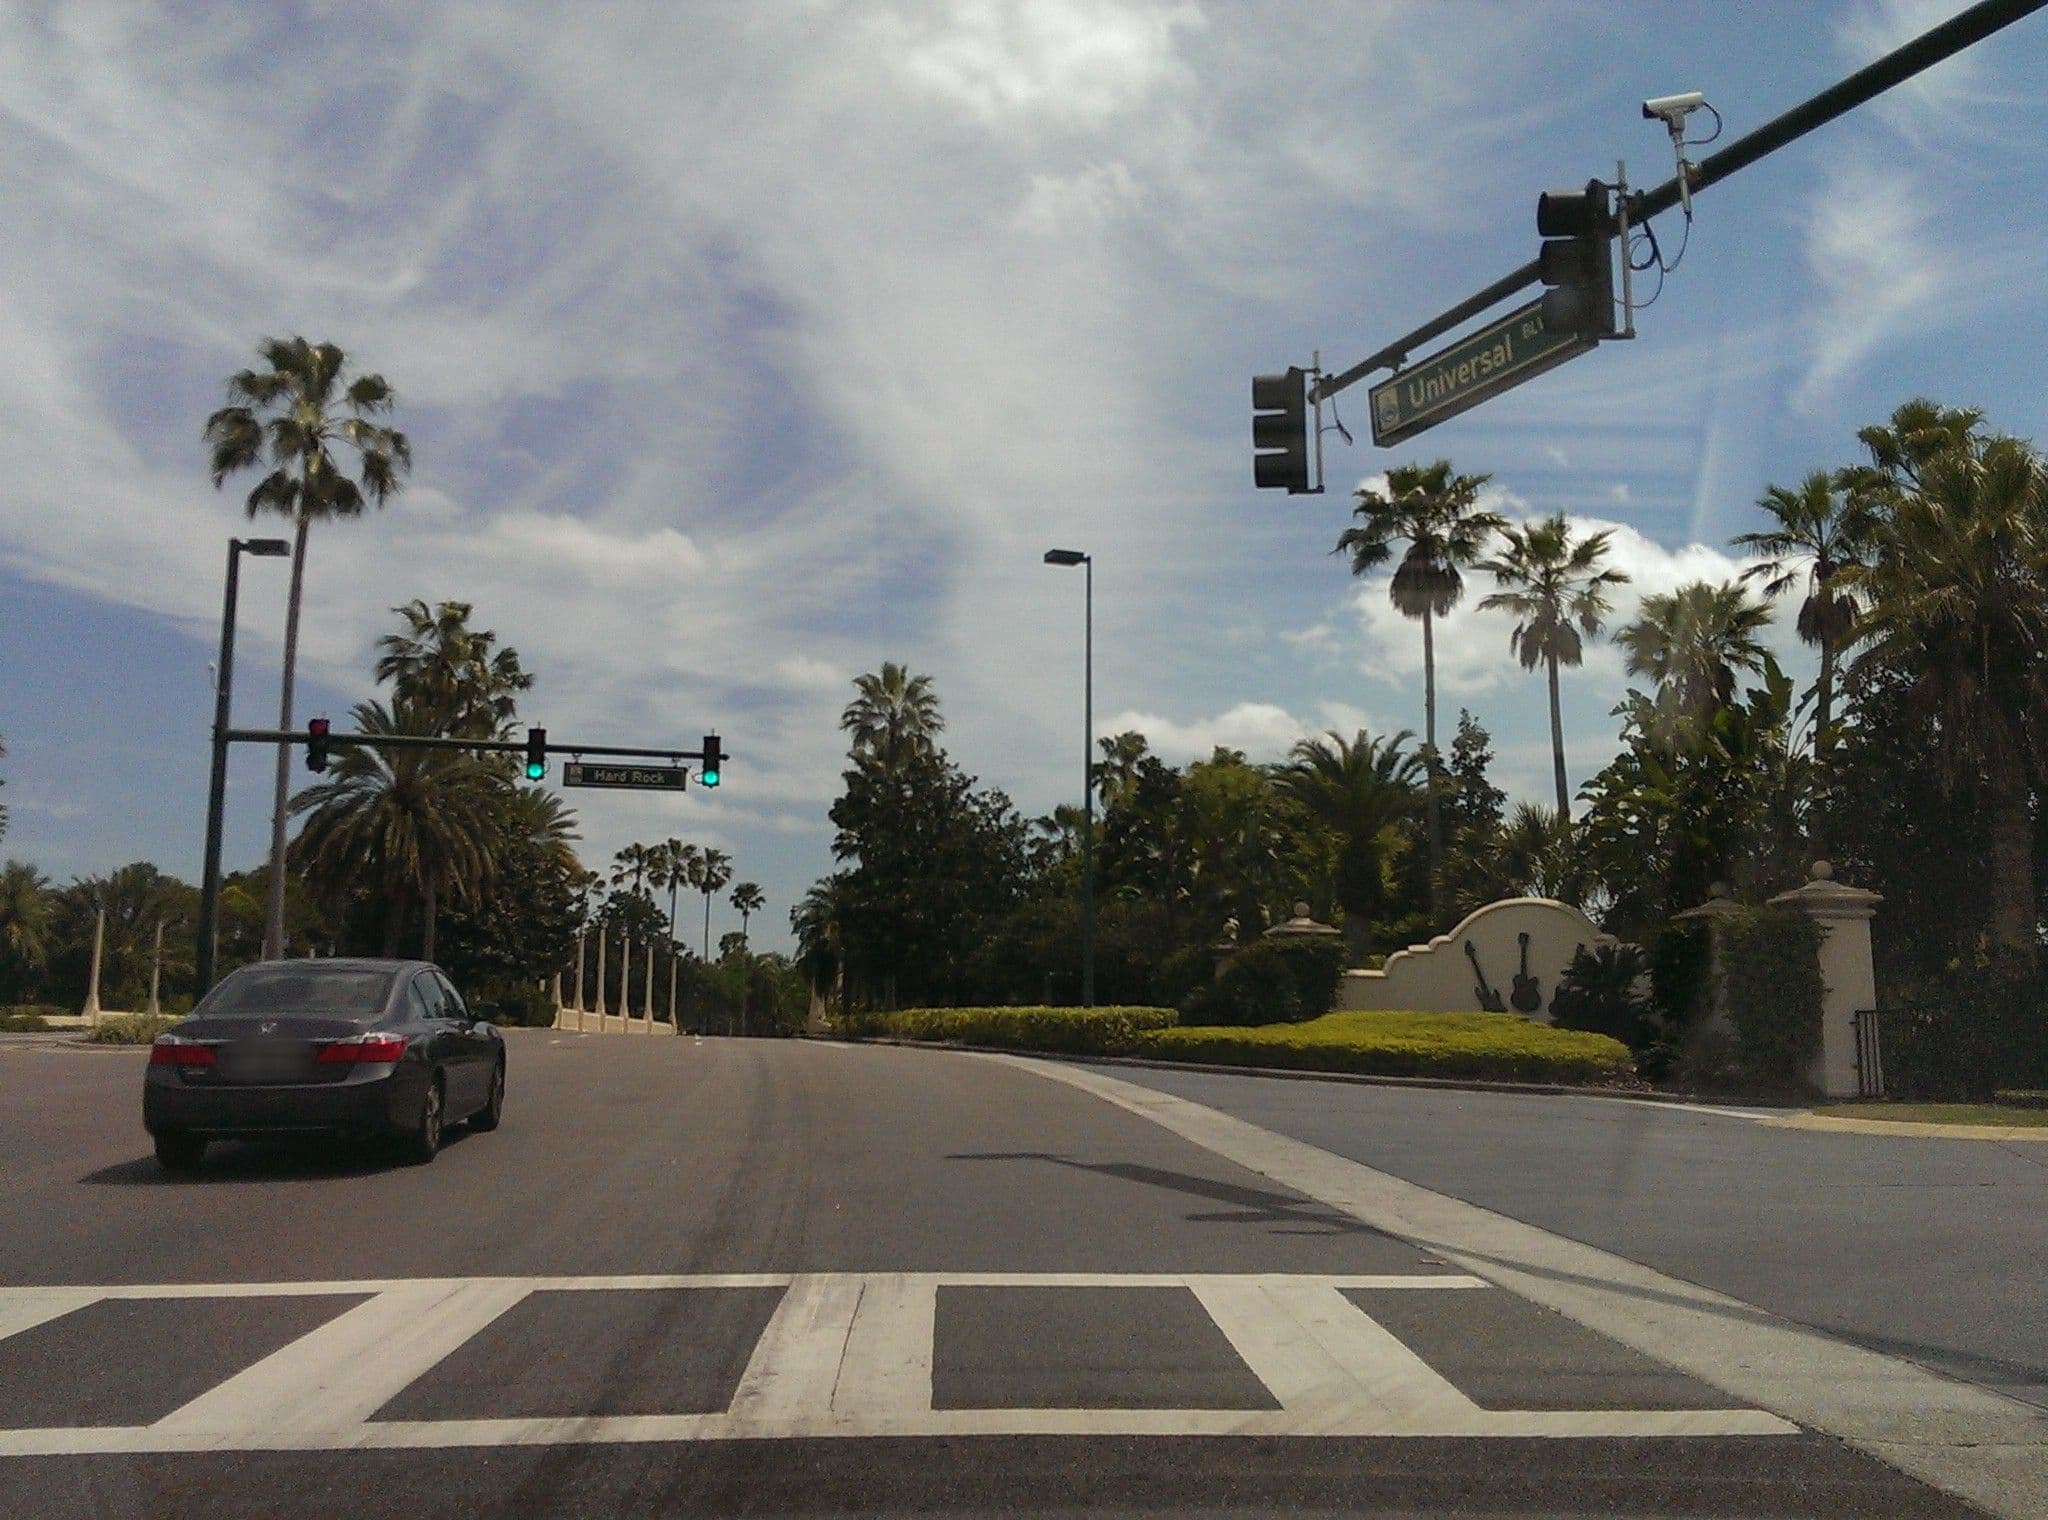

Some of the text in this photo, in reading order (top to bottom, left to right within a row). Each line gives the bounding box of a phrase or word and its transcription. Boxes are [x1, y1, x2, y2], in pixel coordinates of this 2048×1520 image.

[1409, 334, 1513, 407] Universal
[594, 769, 665, 785] Hard Rock
